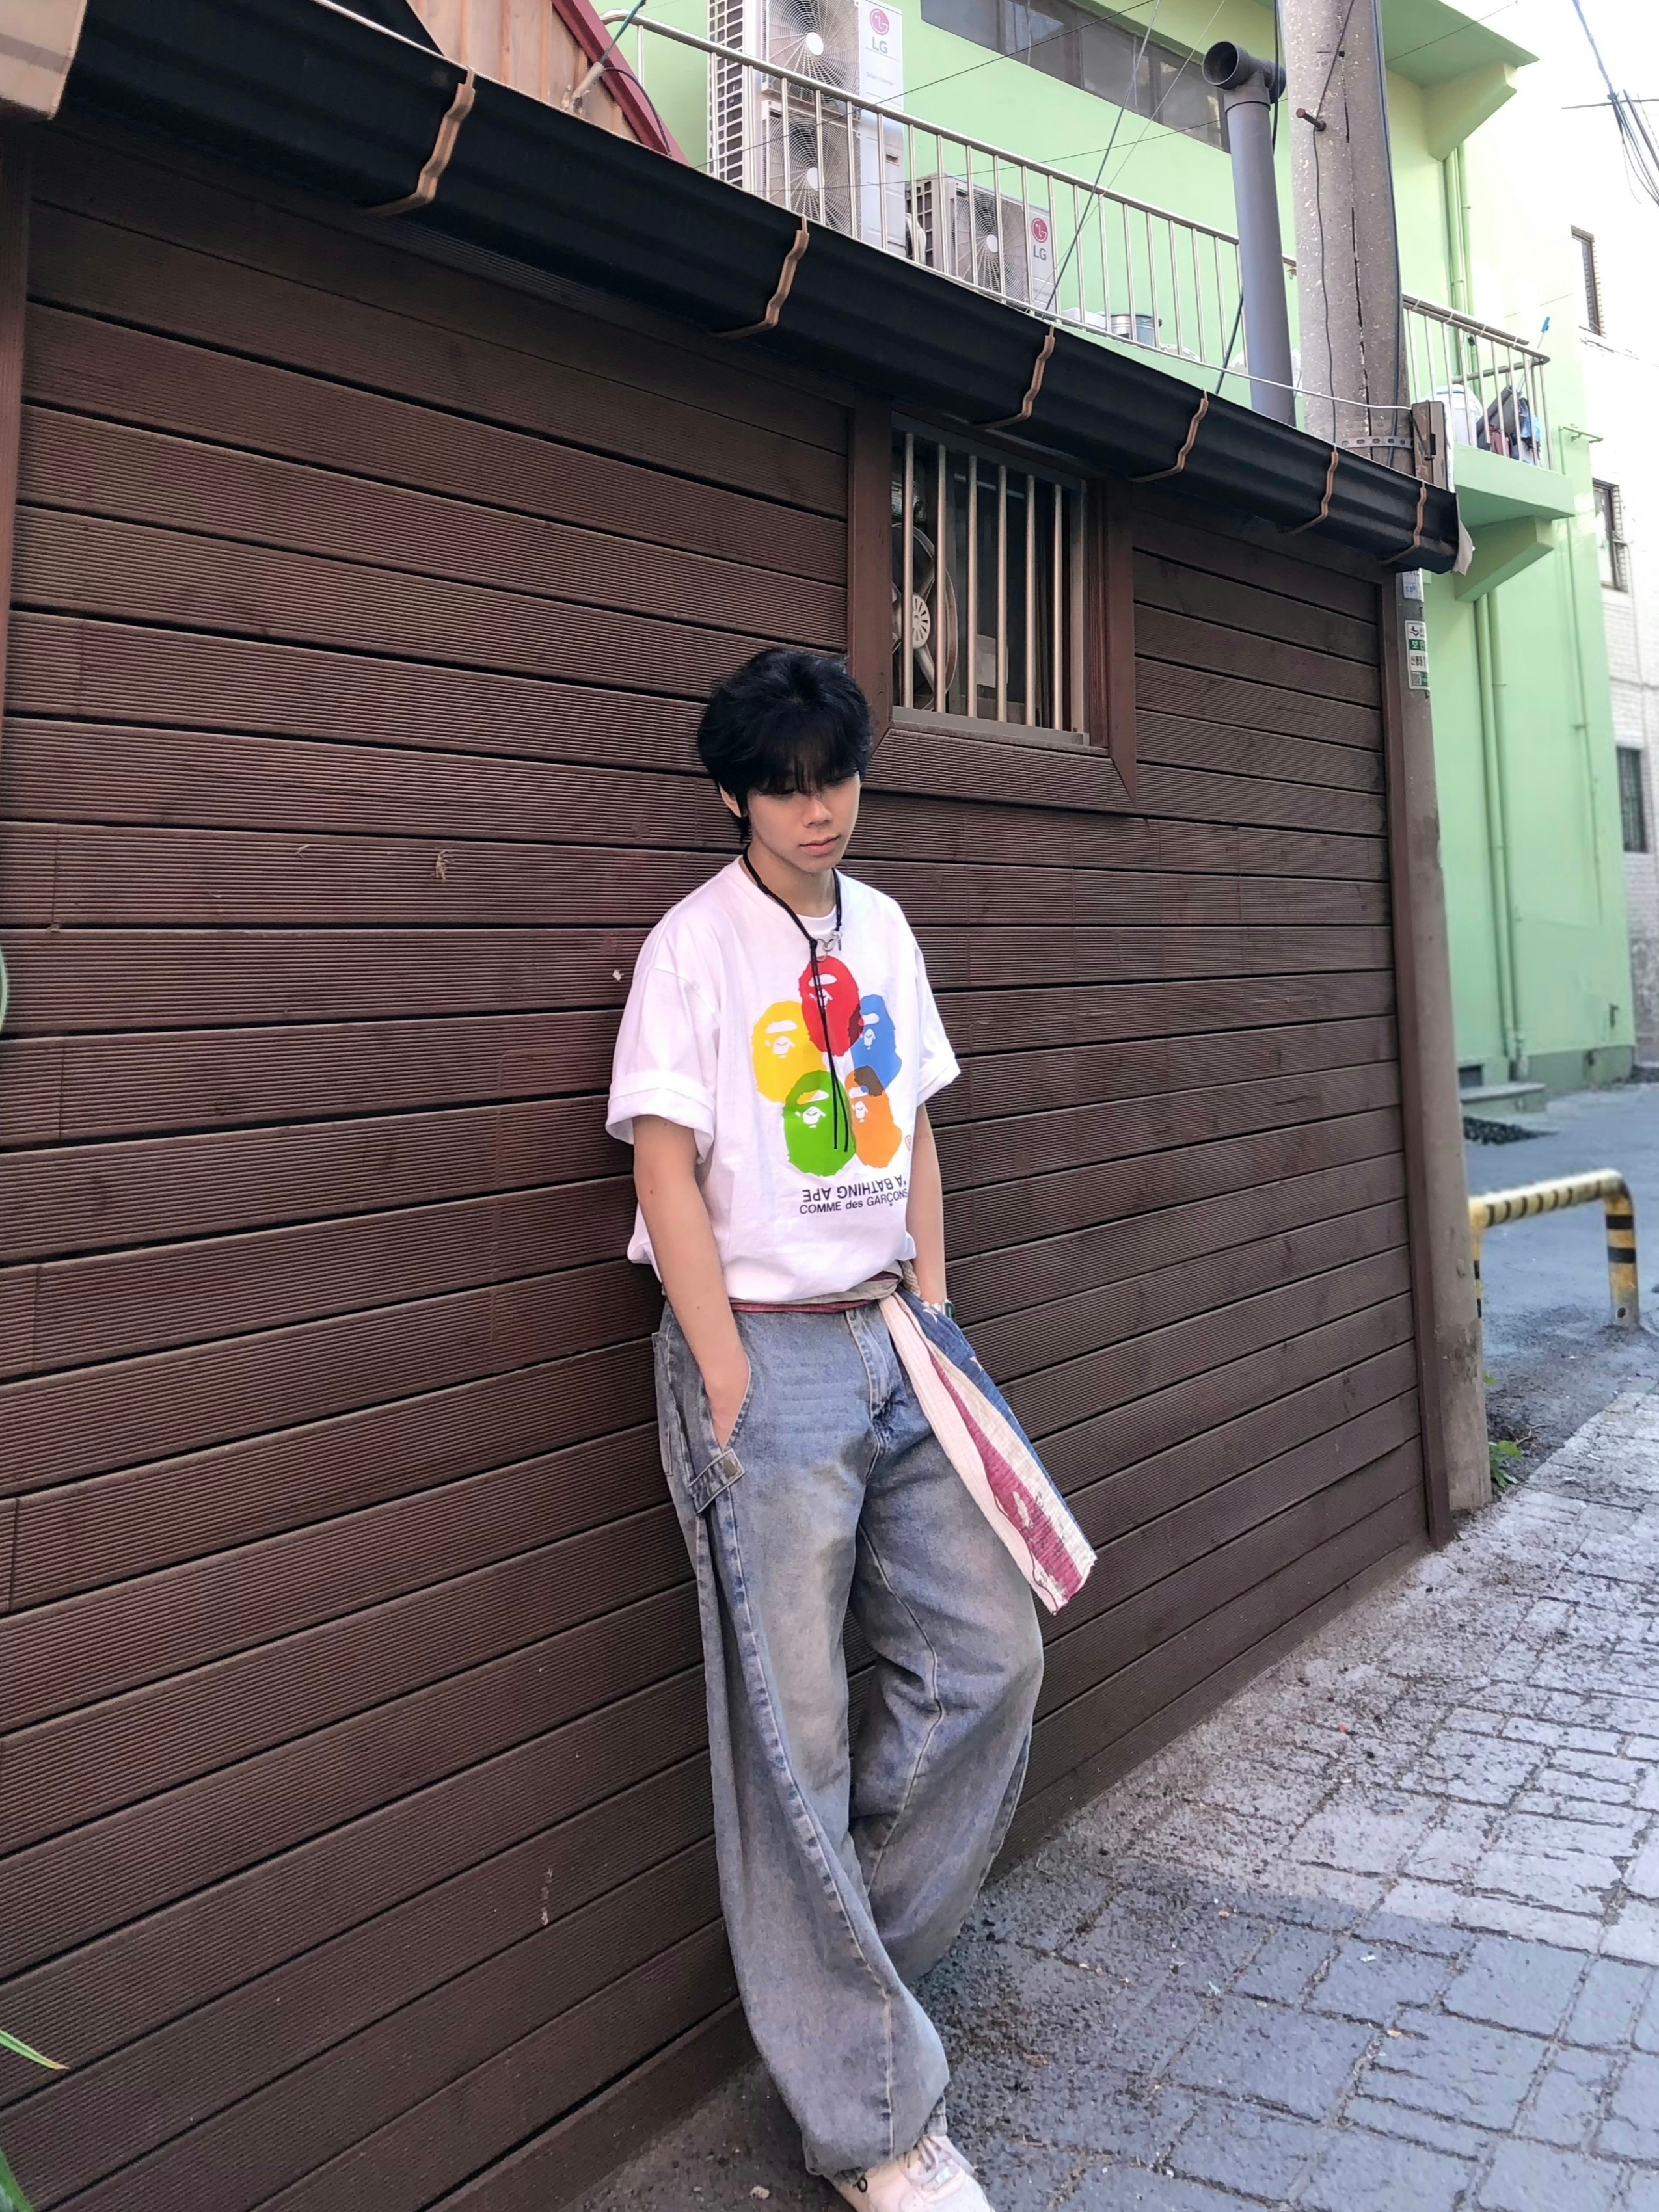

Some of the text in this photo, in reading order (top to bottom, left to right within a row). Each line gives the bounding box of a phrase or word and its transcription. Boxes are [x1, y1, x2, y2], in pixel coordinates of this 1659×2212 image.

[872, 36, 888, 54] LG
[1033, 245, 1047, 261] LG
[802, 1187, 832, 1203] APE
[837, 1177, 893, 1199] BATHING
[799, 1201, 842, 1214] COMME
[845, 1199, 863, 1210] des
